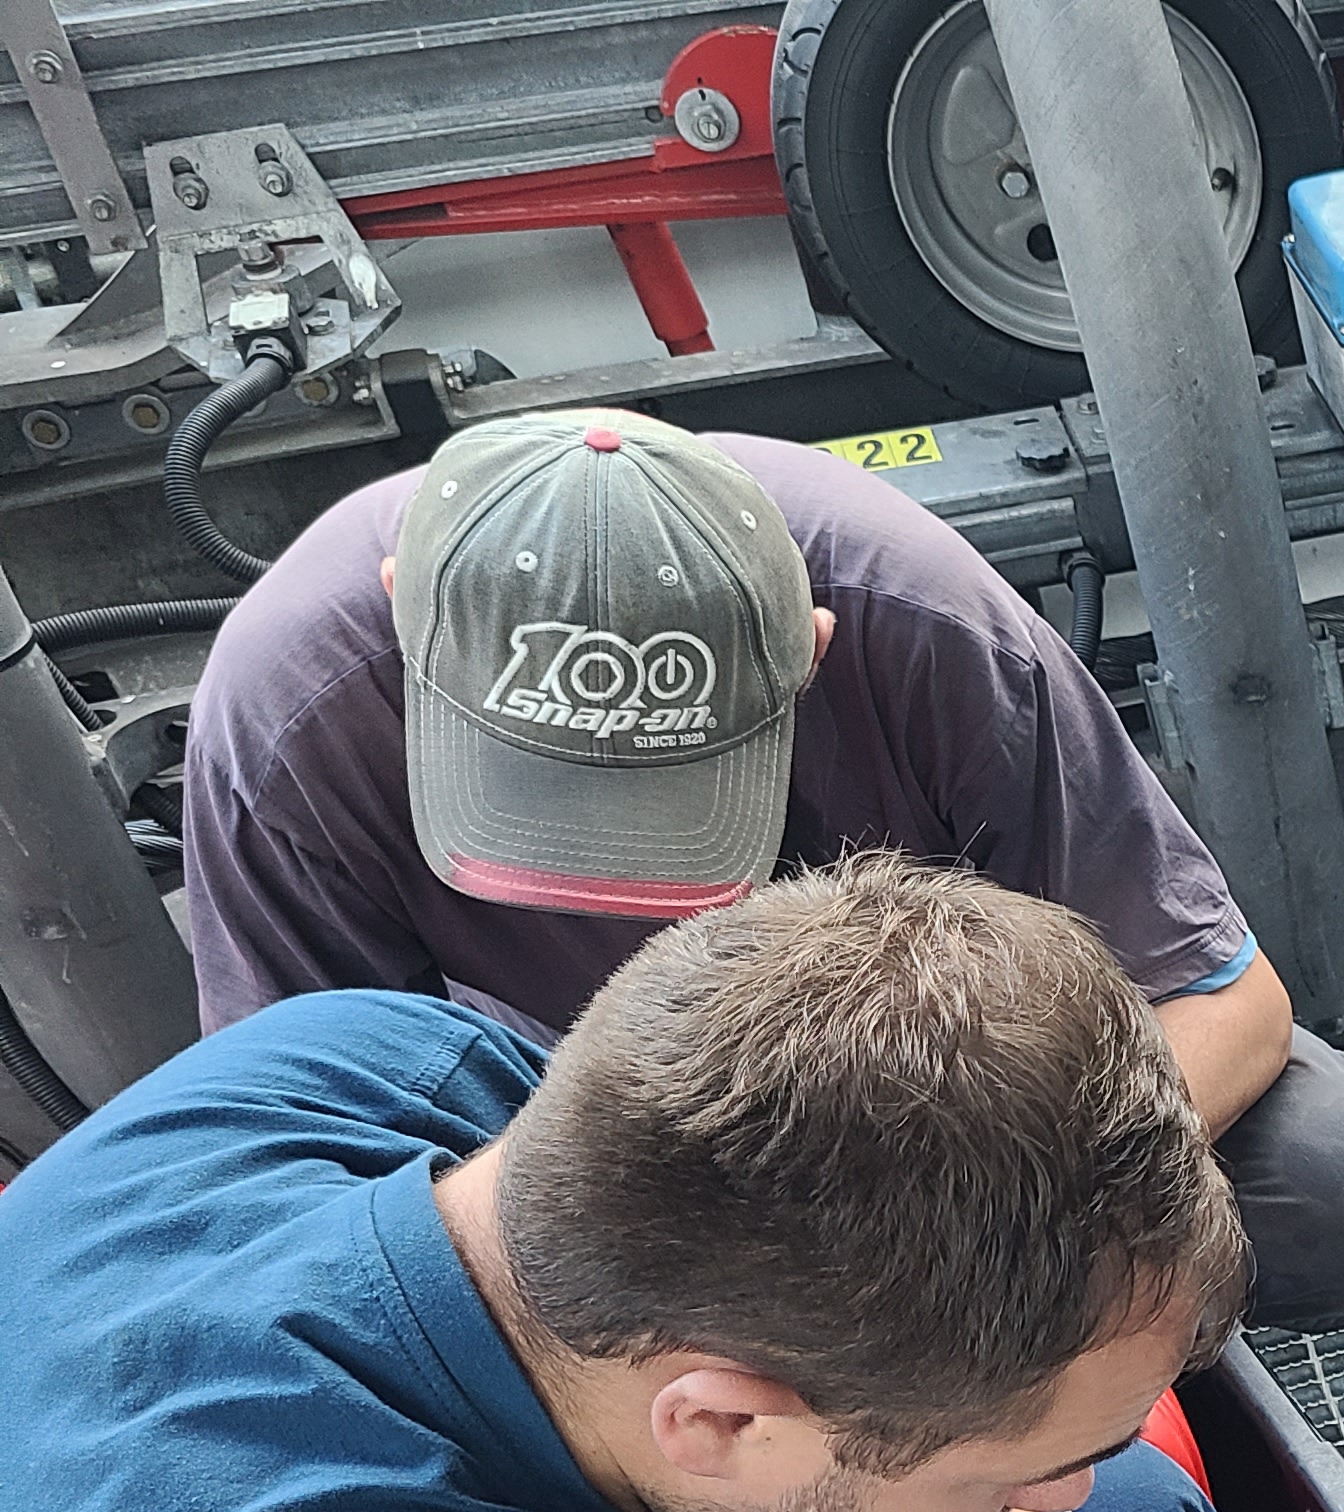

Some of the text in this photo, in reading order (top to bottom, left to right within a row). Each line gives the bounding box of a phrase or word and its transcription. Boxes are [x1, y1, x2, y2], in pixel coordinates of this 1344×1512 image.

[814, 433, 932, 469] 22
[633, 731, 706, 749] SINCE 1920
